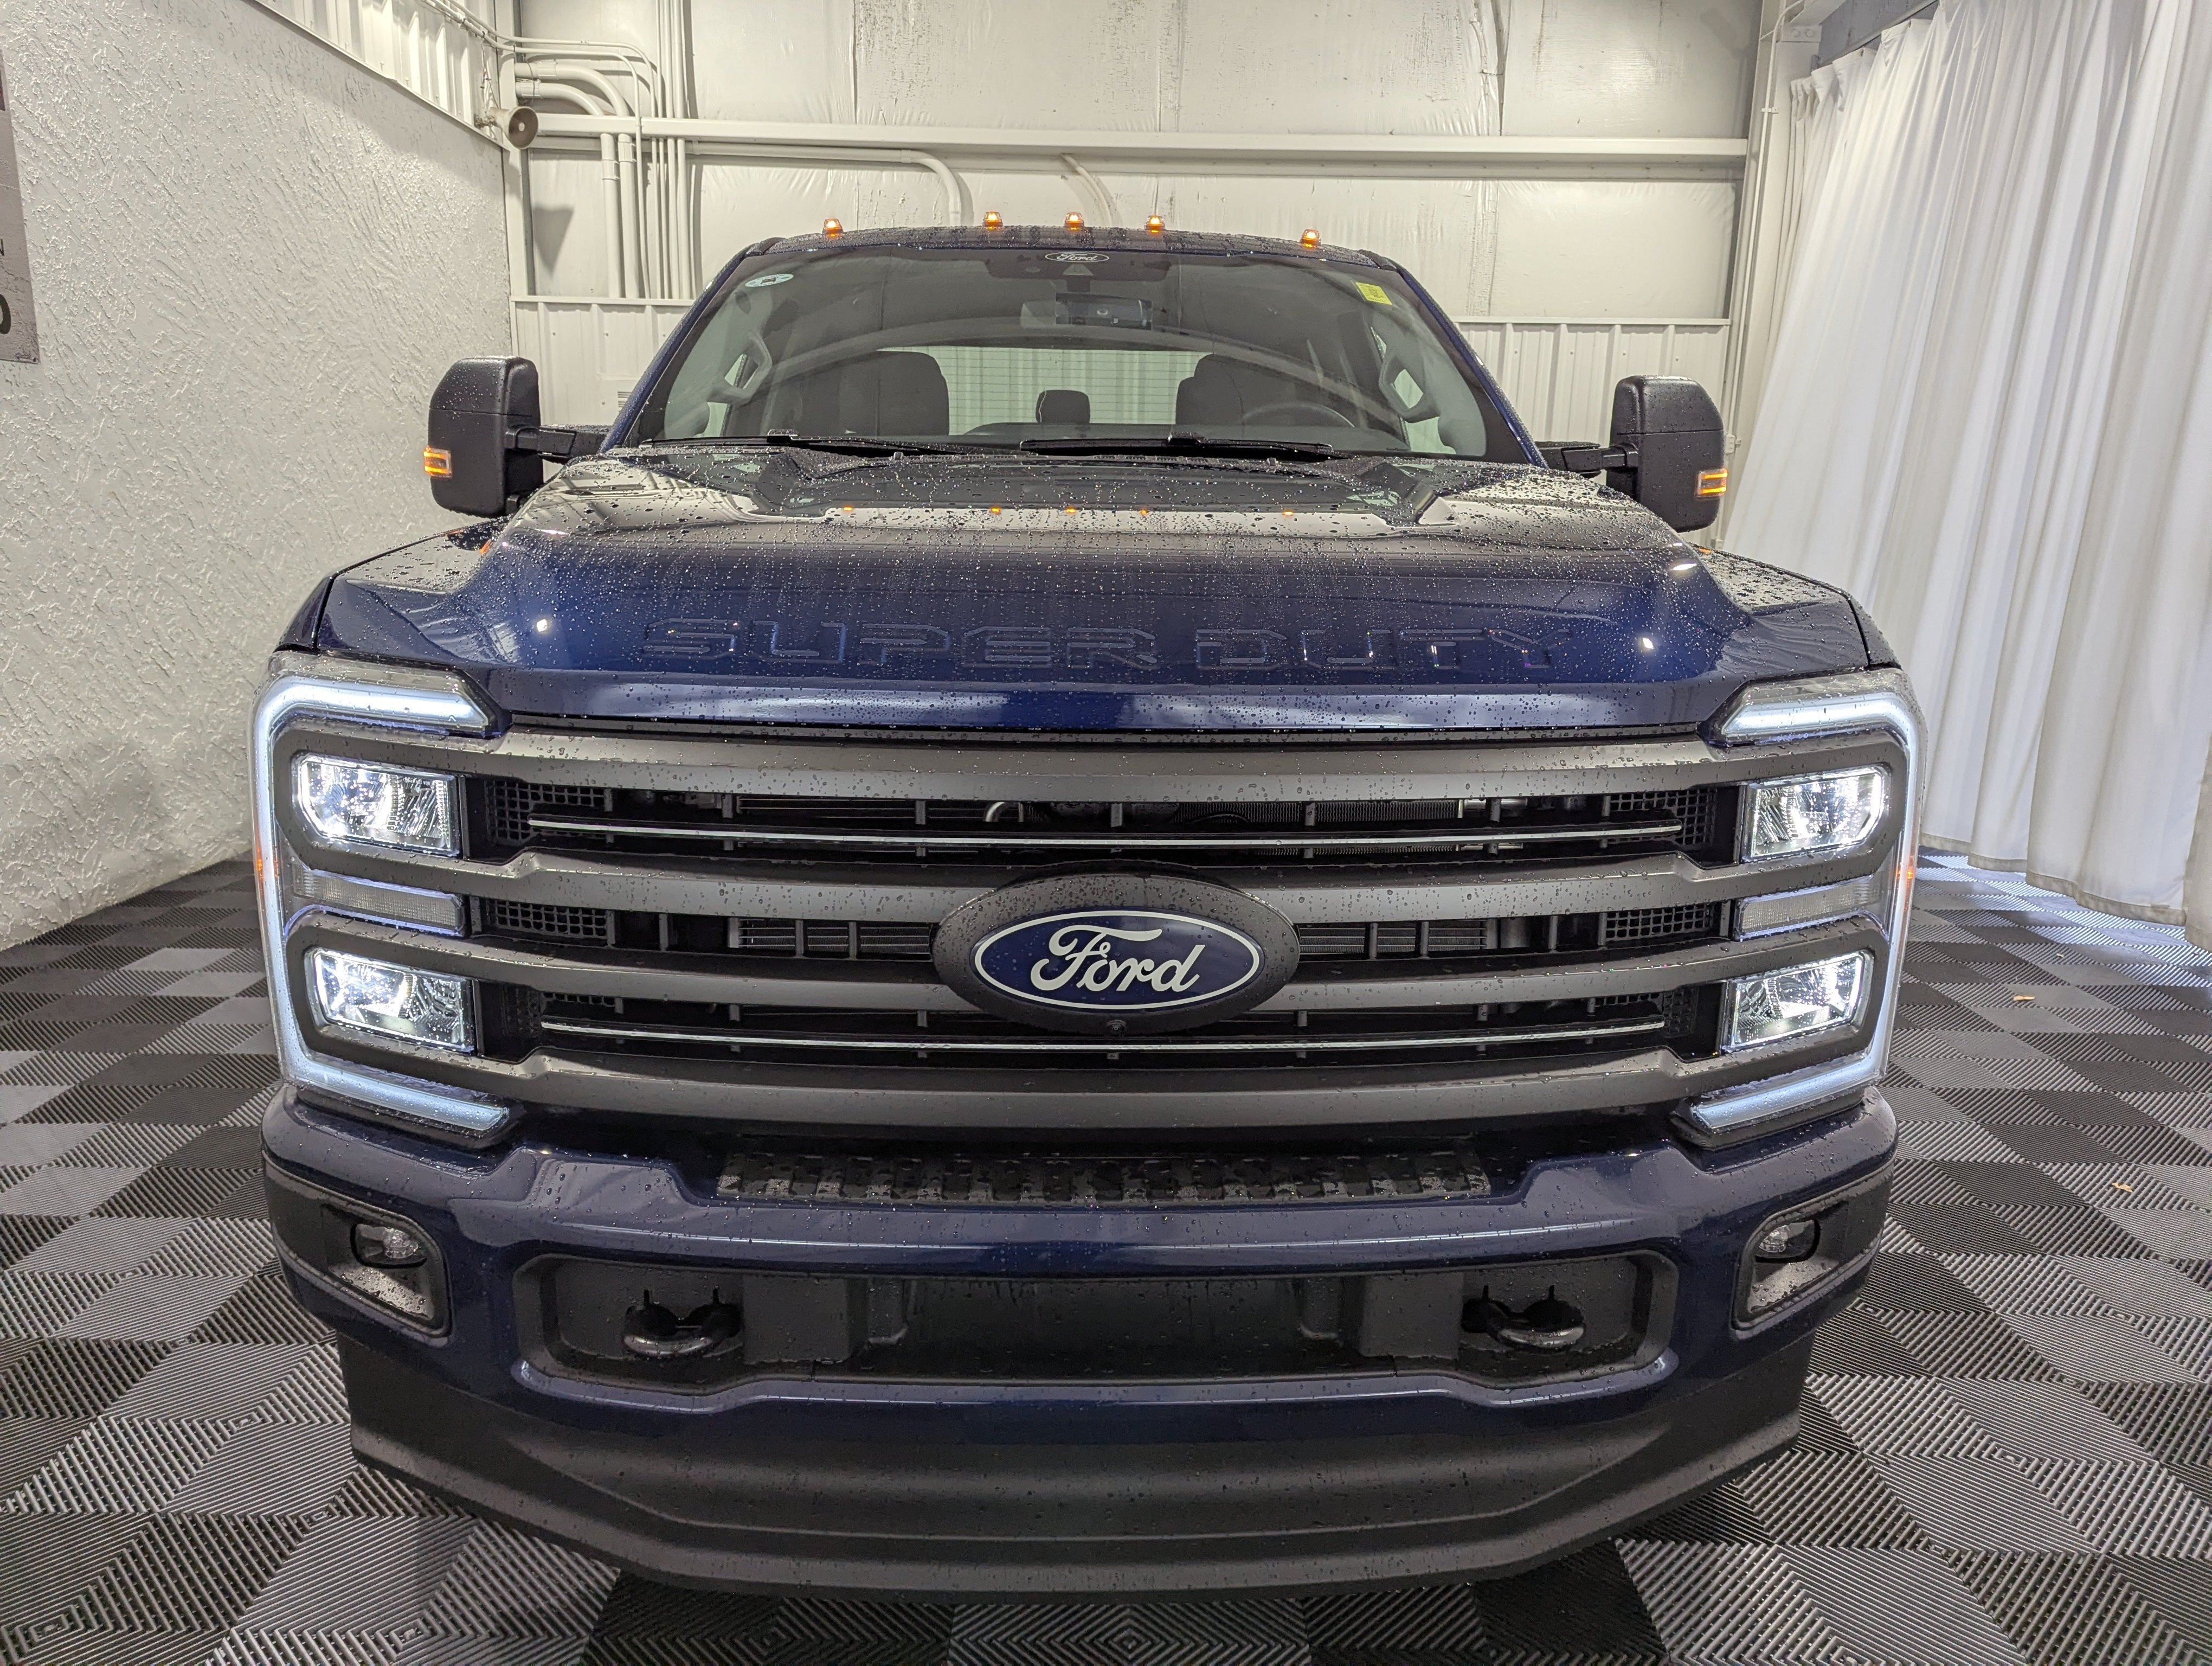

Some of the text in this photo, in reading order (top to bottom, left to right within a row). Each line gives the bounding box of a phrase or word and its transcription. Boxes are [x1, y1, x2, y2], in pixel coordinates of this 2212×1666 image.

[1056, 253, 1098, 261] Ford
[644, 617, 1571, 670] SUPER DUTY
[1030, 924, 1206, 992] Ford
